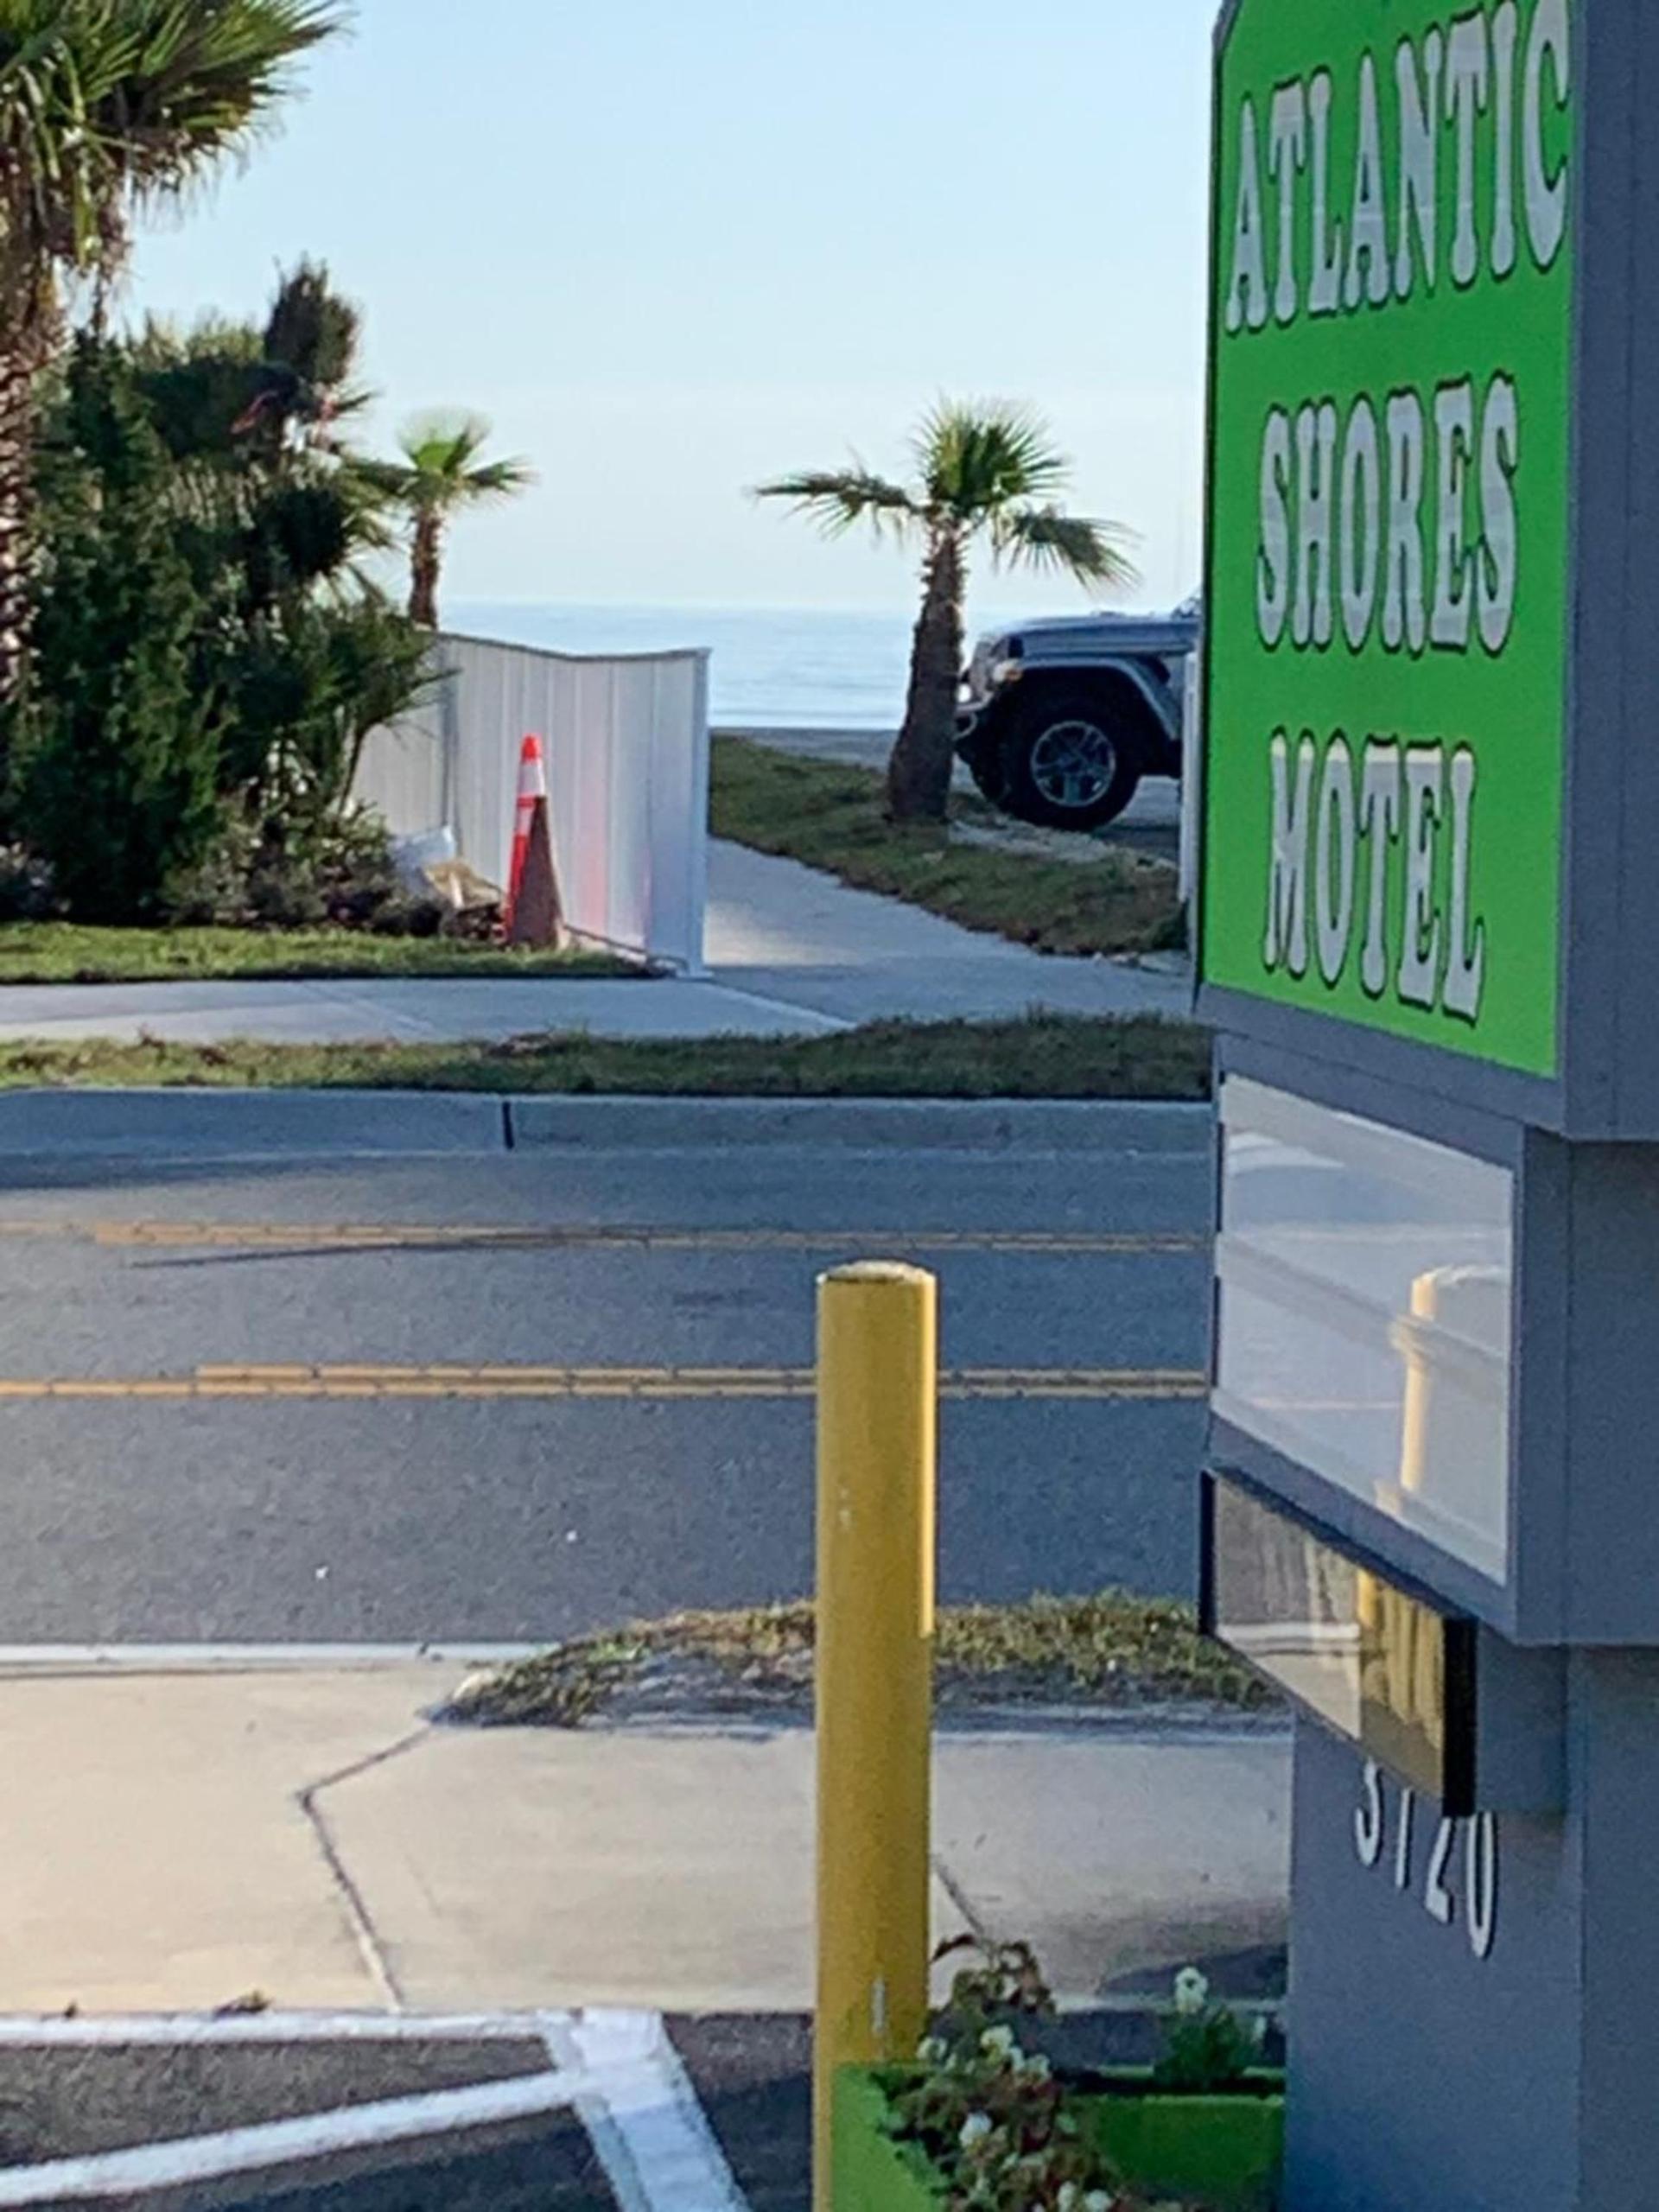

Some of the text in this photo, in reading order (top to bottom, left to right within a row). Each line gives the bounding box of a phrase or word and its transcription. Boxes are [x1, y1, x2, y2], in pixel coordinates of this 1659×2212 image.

[1224, 0, 1568, 335] ATLANTIC
[1255, 369, 1518, 658] SHORES
[1263, 726, 1486, 1027] MOTEL
